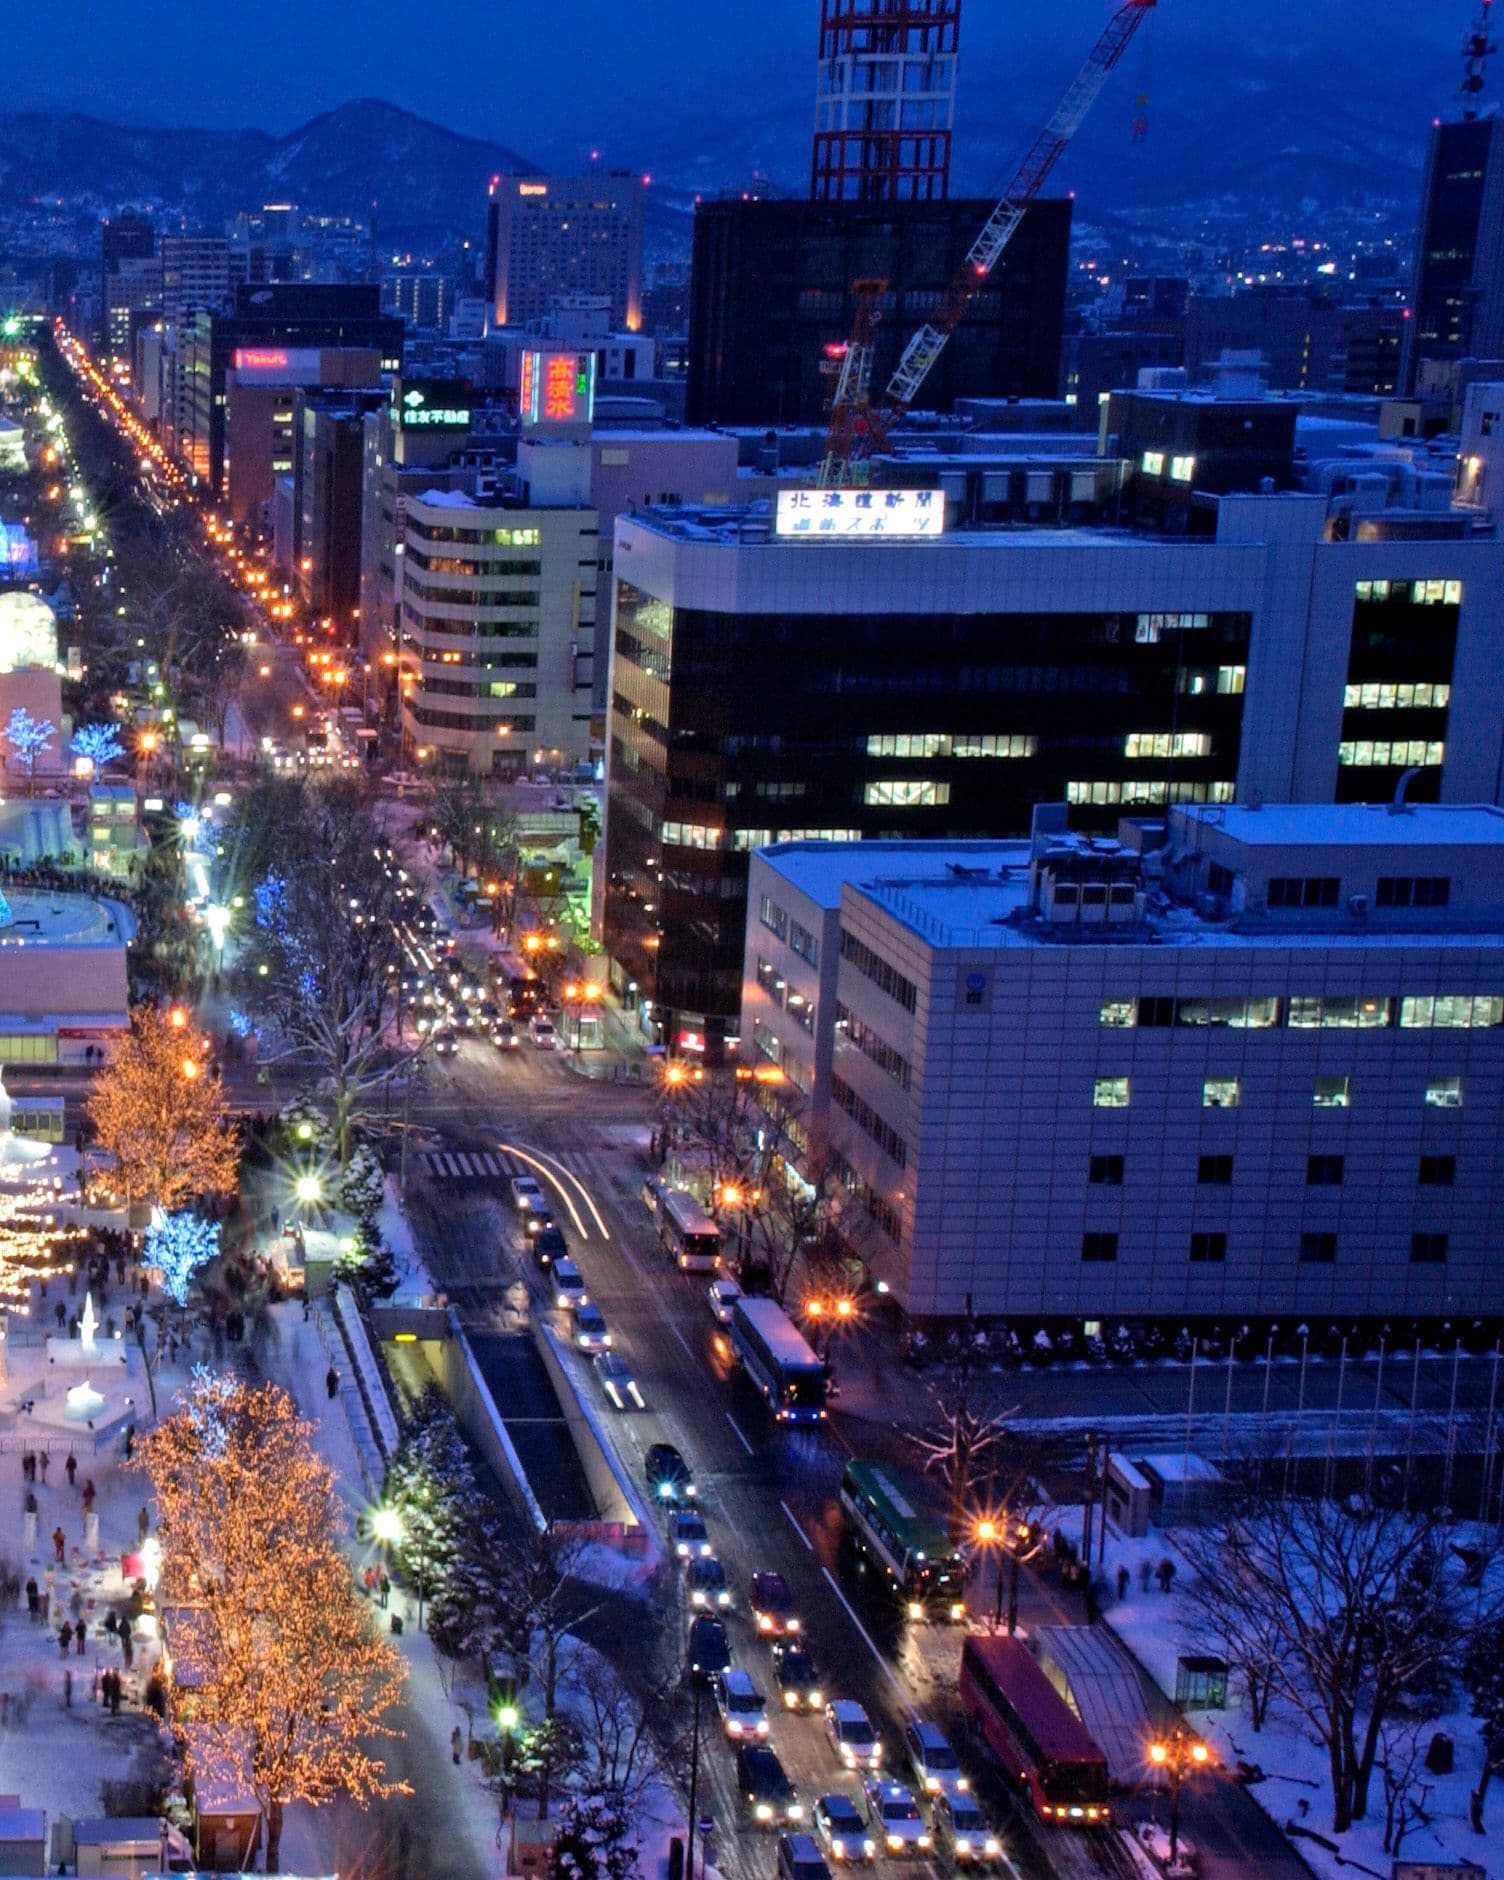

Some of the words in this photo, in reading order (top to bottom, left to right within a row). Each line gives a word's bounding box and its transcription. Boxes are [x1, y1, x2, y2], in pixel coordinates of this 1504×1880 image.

[245, 351, 287, 368] Yakult
[403, 409, 470, 425] 住友不動産
[790, 491, 933, 509] 北海道新聞
